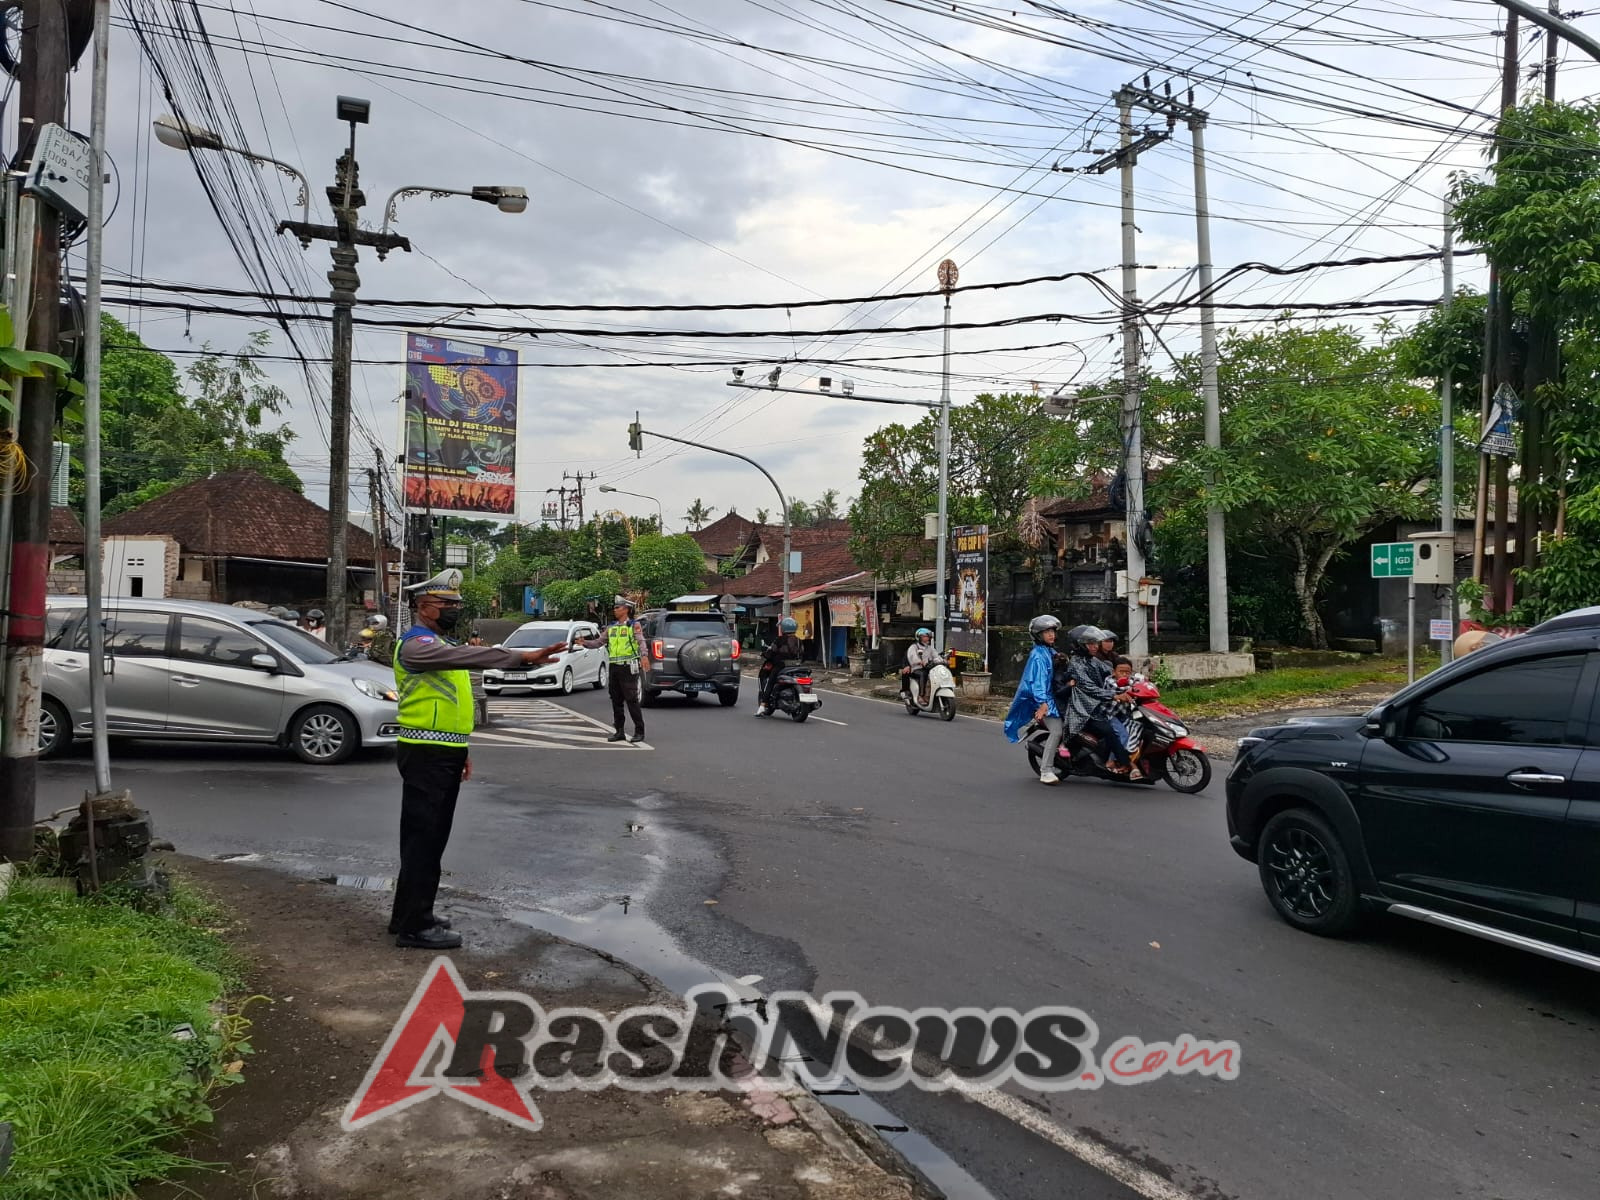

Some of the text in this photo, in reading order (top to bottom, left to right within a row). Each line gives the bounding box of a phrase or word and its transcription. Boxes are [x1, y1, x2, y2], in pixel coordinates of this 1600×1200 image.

[427, 417, 503, 433] BALI DJ FEST 2023
[1395, 556, 1411, 564] IGD
